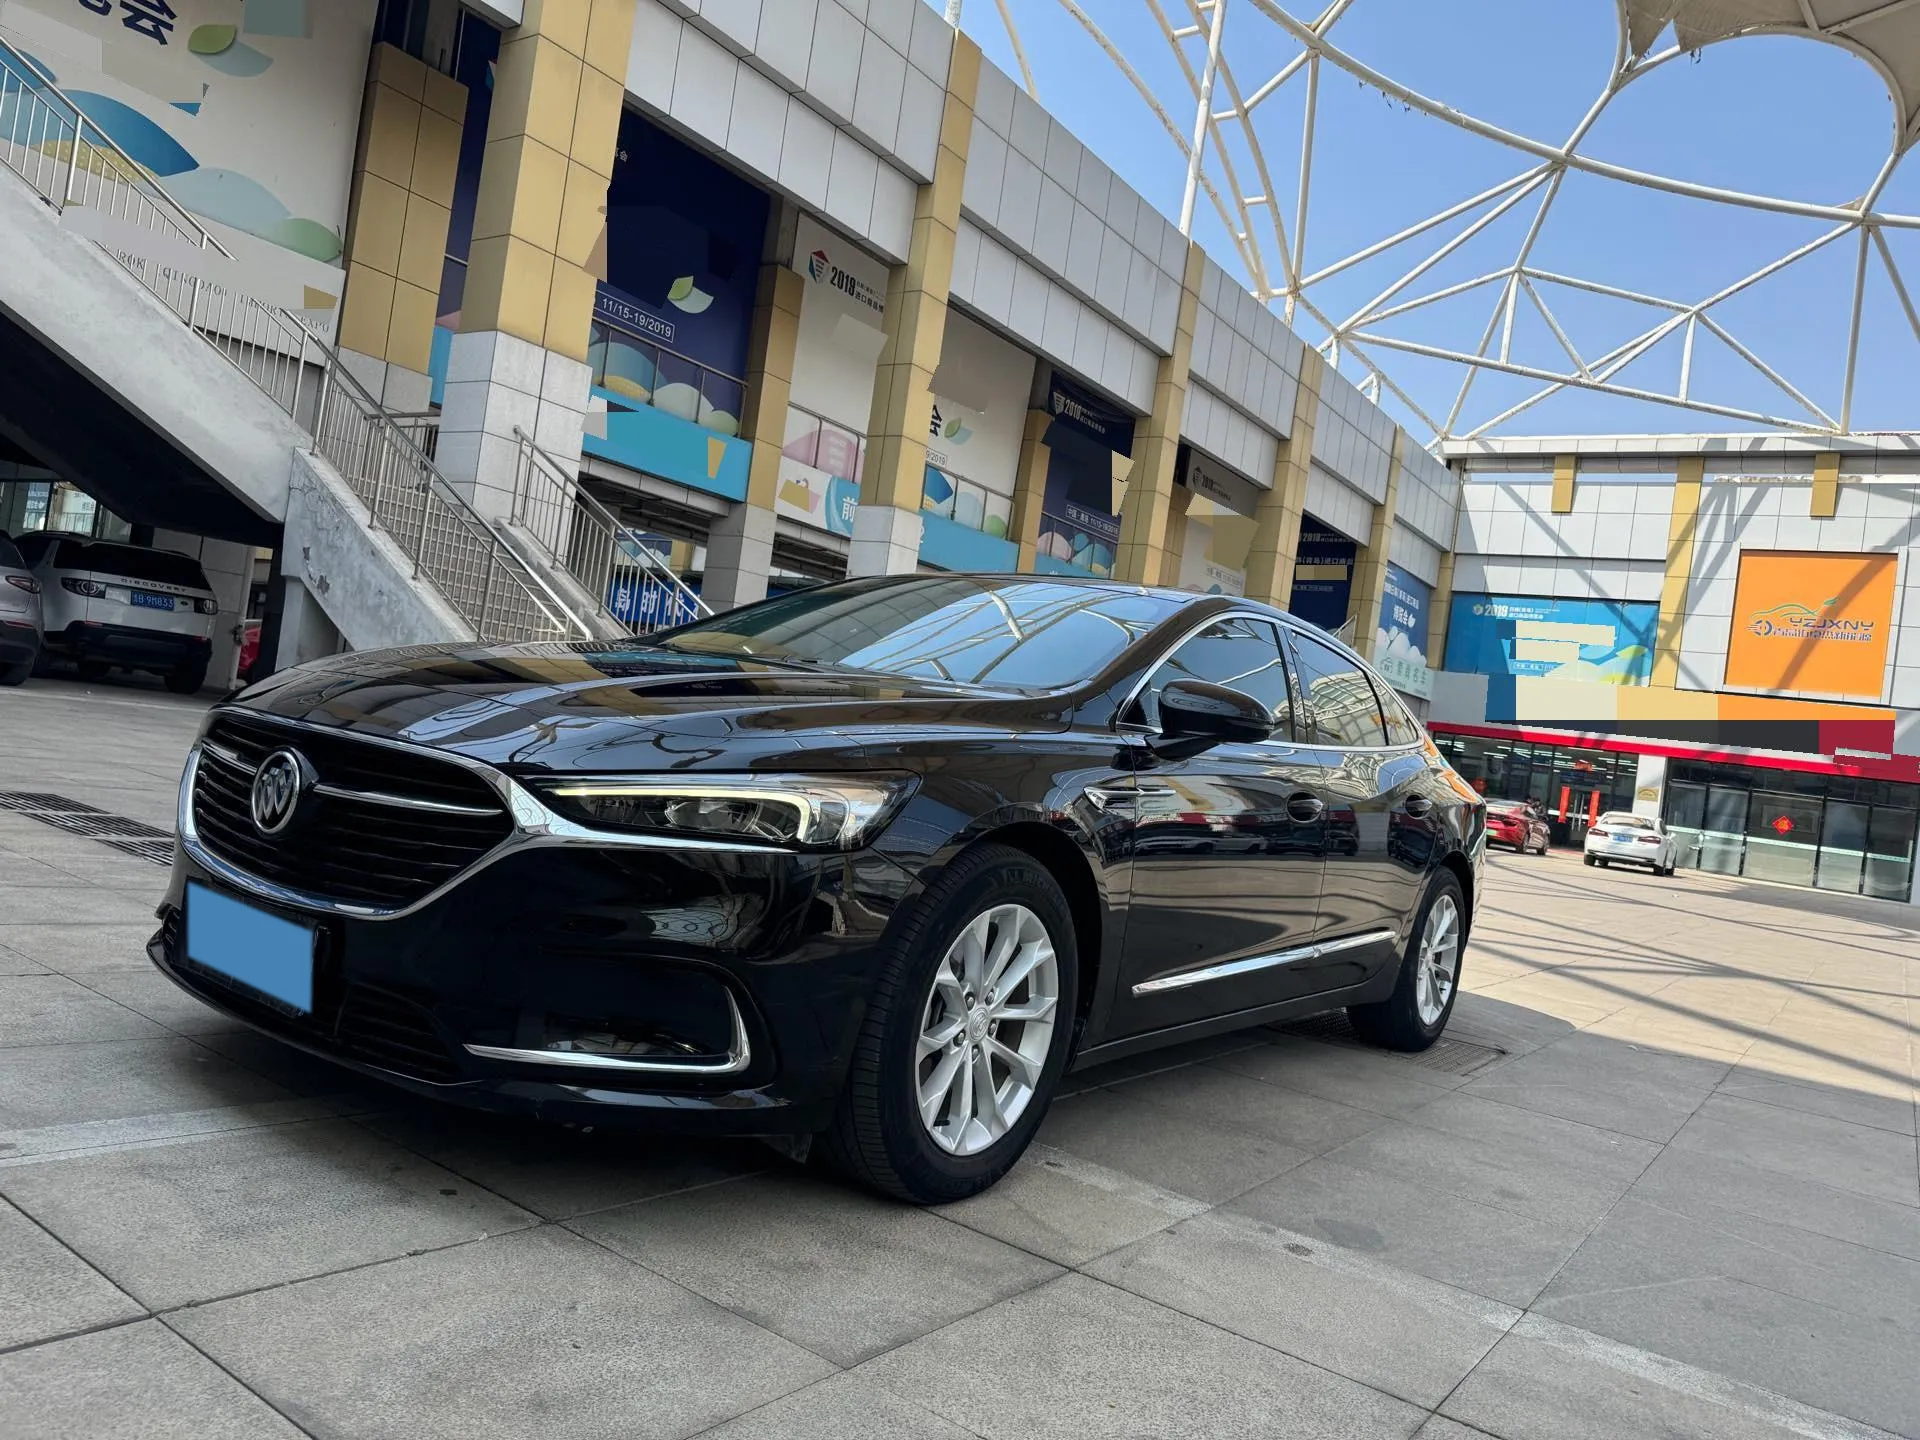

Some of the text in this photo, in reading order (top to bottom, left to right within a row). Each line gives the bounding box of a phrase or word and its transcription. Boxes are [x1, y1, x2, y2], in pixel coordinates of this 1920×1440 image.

[829, 266, 857, 297] 2019
[602, 298, 672, 338] 11/15-19/2019
[841, 496, 858, 523] 前
[121, 578, 187, 593] DISCOVERY
